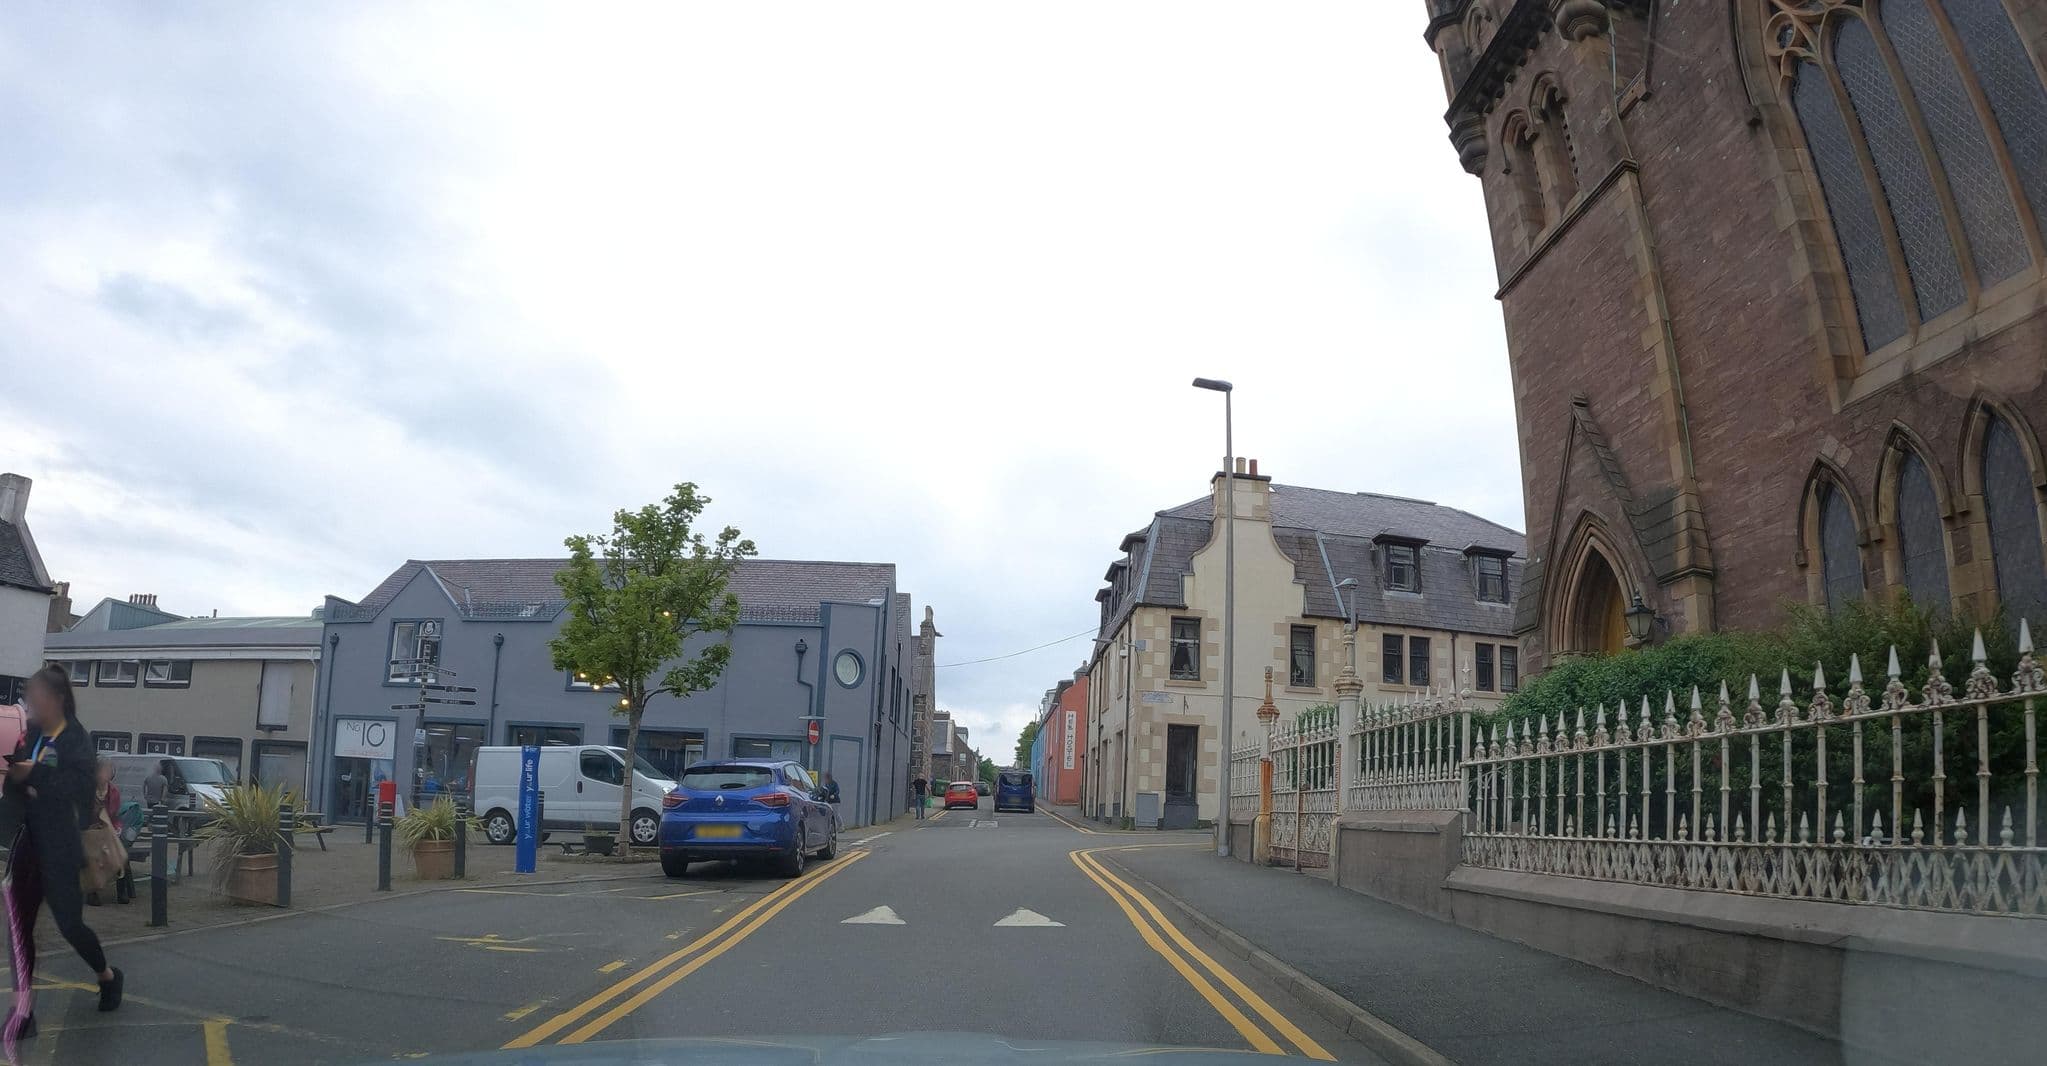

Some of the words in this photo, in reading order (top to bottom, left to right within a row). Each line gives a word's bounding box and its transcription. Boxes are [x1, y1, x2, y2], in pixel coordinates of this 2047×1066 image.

[361, 721, 386, 747] 10
[1066, 734, 1074, 767] HOSTEL
[525, 759, 534, 772] life
[526, 773, 534, 792] yur
[524, 820, 533, 839] yur
